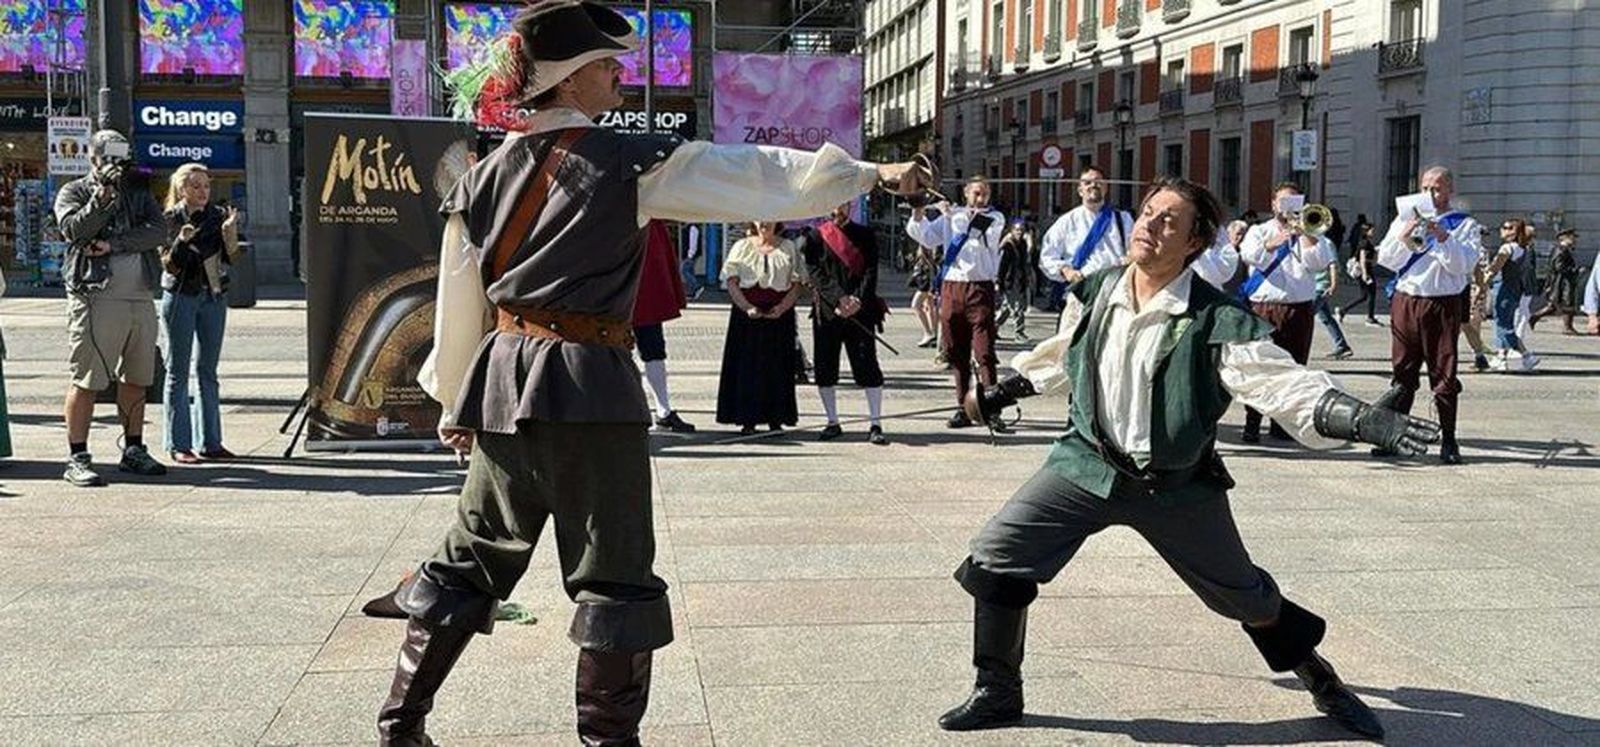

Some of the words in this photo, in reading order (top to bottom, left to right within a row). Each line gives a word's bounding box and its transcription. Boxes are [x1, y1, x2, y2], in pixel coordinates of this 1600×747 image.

[141, 106, 237, 131] Change
[744, 126, 833, 145] ZAPSHOP
[149, 143, 212, 160] Change
[321, 134, 422, 204] Motín
[320, 206, 335, 215] DE
[338, 206, 397, 215] ARGANDA
